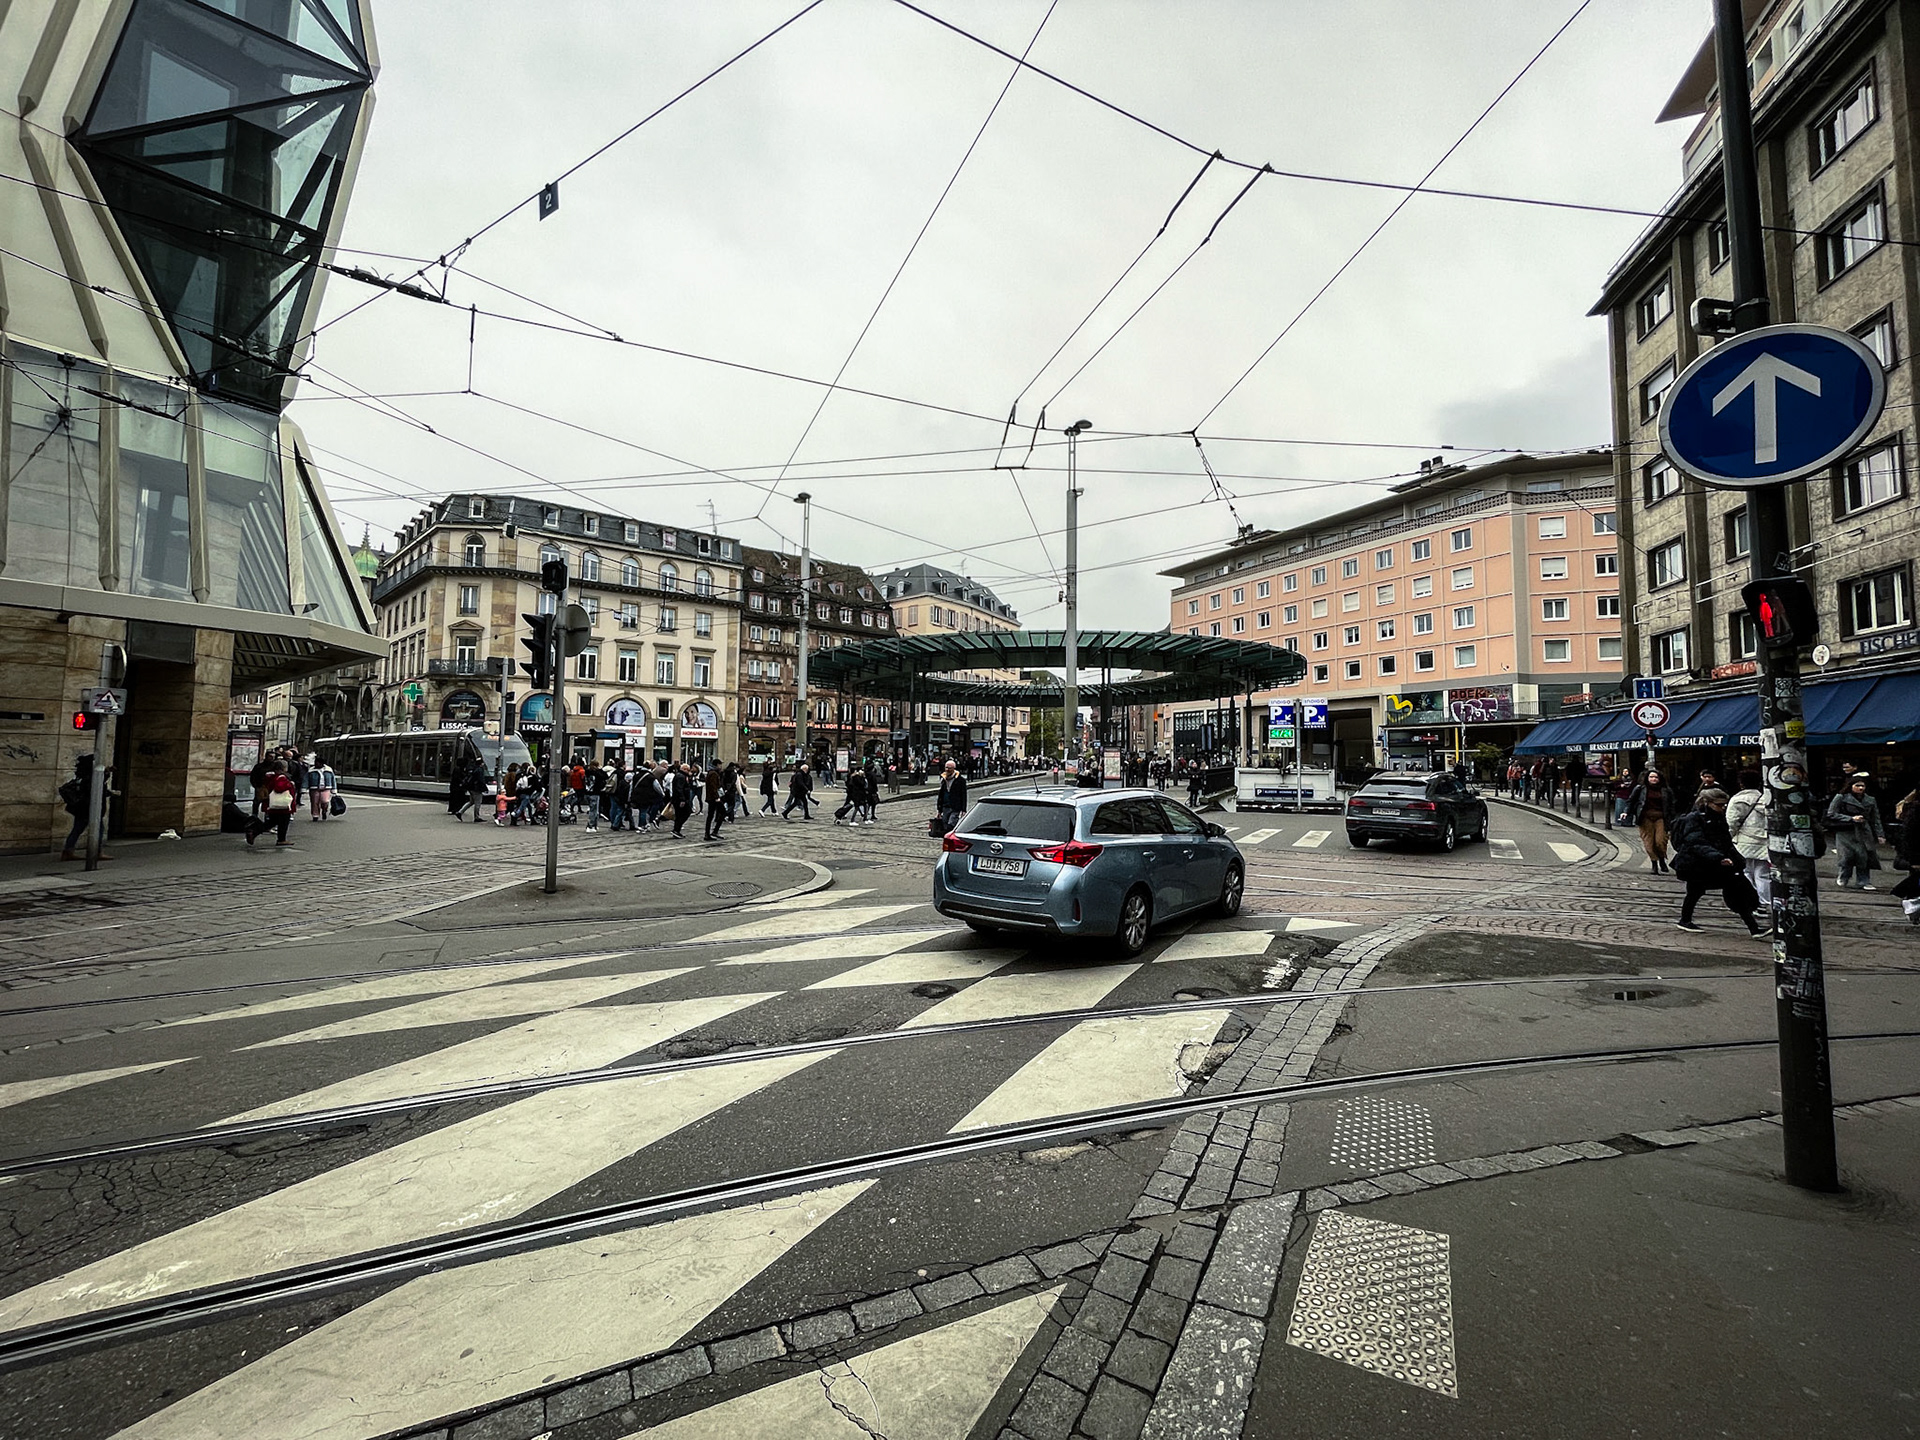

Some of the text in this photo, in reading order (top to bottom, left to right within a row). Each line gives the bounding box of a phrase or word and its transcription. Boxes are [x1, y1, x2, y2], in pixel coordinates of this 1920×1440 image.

[545, 193, 552, 210] 2
[1860, 630, 1920, 657] FISCHE
[1270, 706, 1283, 721] P
[1303, 706, 1318, 722] P
[441, 722, 469, 730] LISSAC
[522, 724, 549, 732] LISSAC
[1669, 735, 1723, 747] RESTAURANT
[980, 857, 992, 869] LD
[1003, 860, 1020, 872] 758
